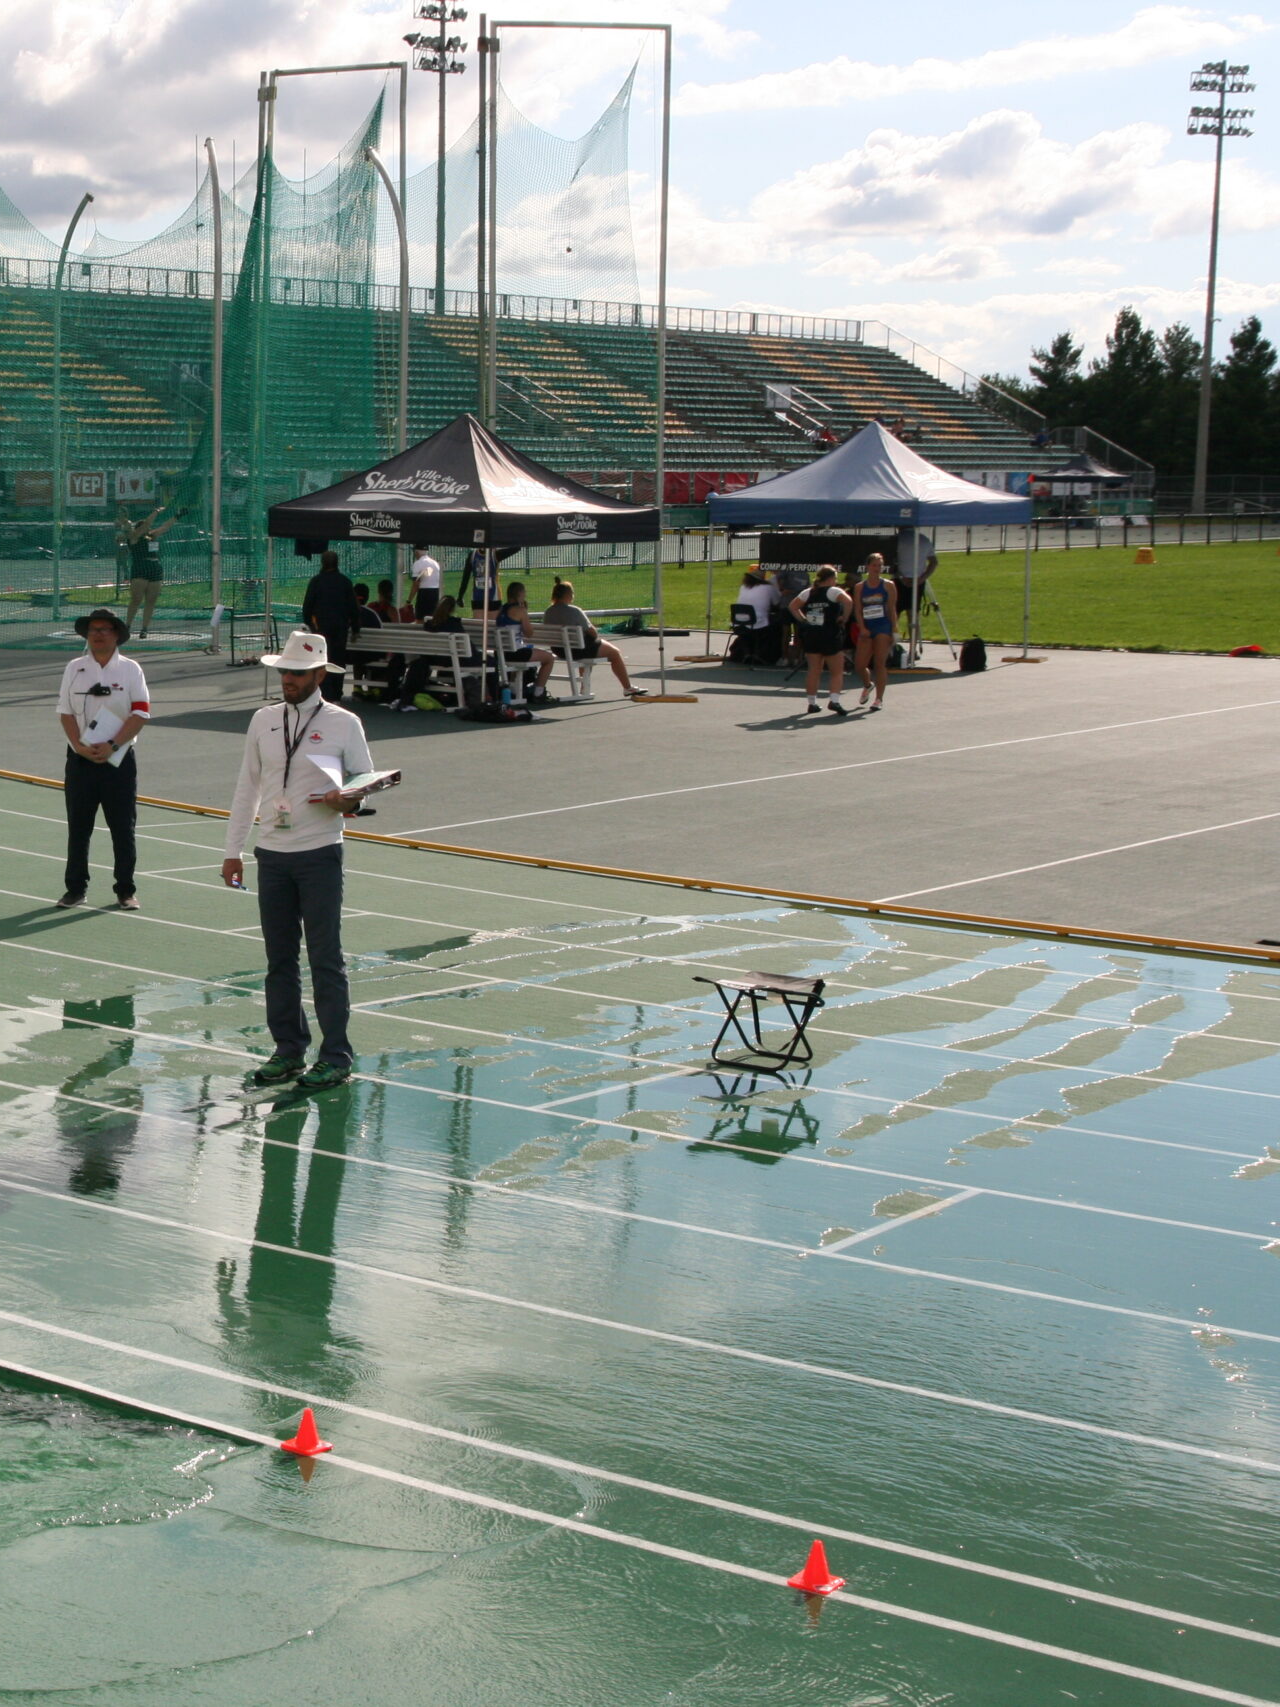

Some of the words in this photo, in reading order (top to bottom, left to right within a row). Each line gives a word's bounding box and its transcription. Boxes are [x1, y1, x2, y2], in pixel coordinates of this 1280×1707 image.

[72, 476, 102, 494] YEP
[358, 471, 470, 495] Sherbrooke
[415, 470, 441, 483] Ville
[442, 475, 454, 483] de
[349, 512, 401, 529] Sherbrooke
[557, 515, 597, 531] Sherbrooke
